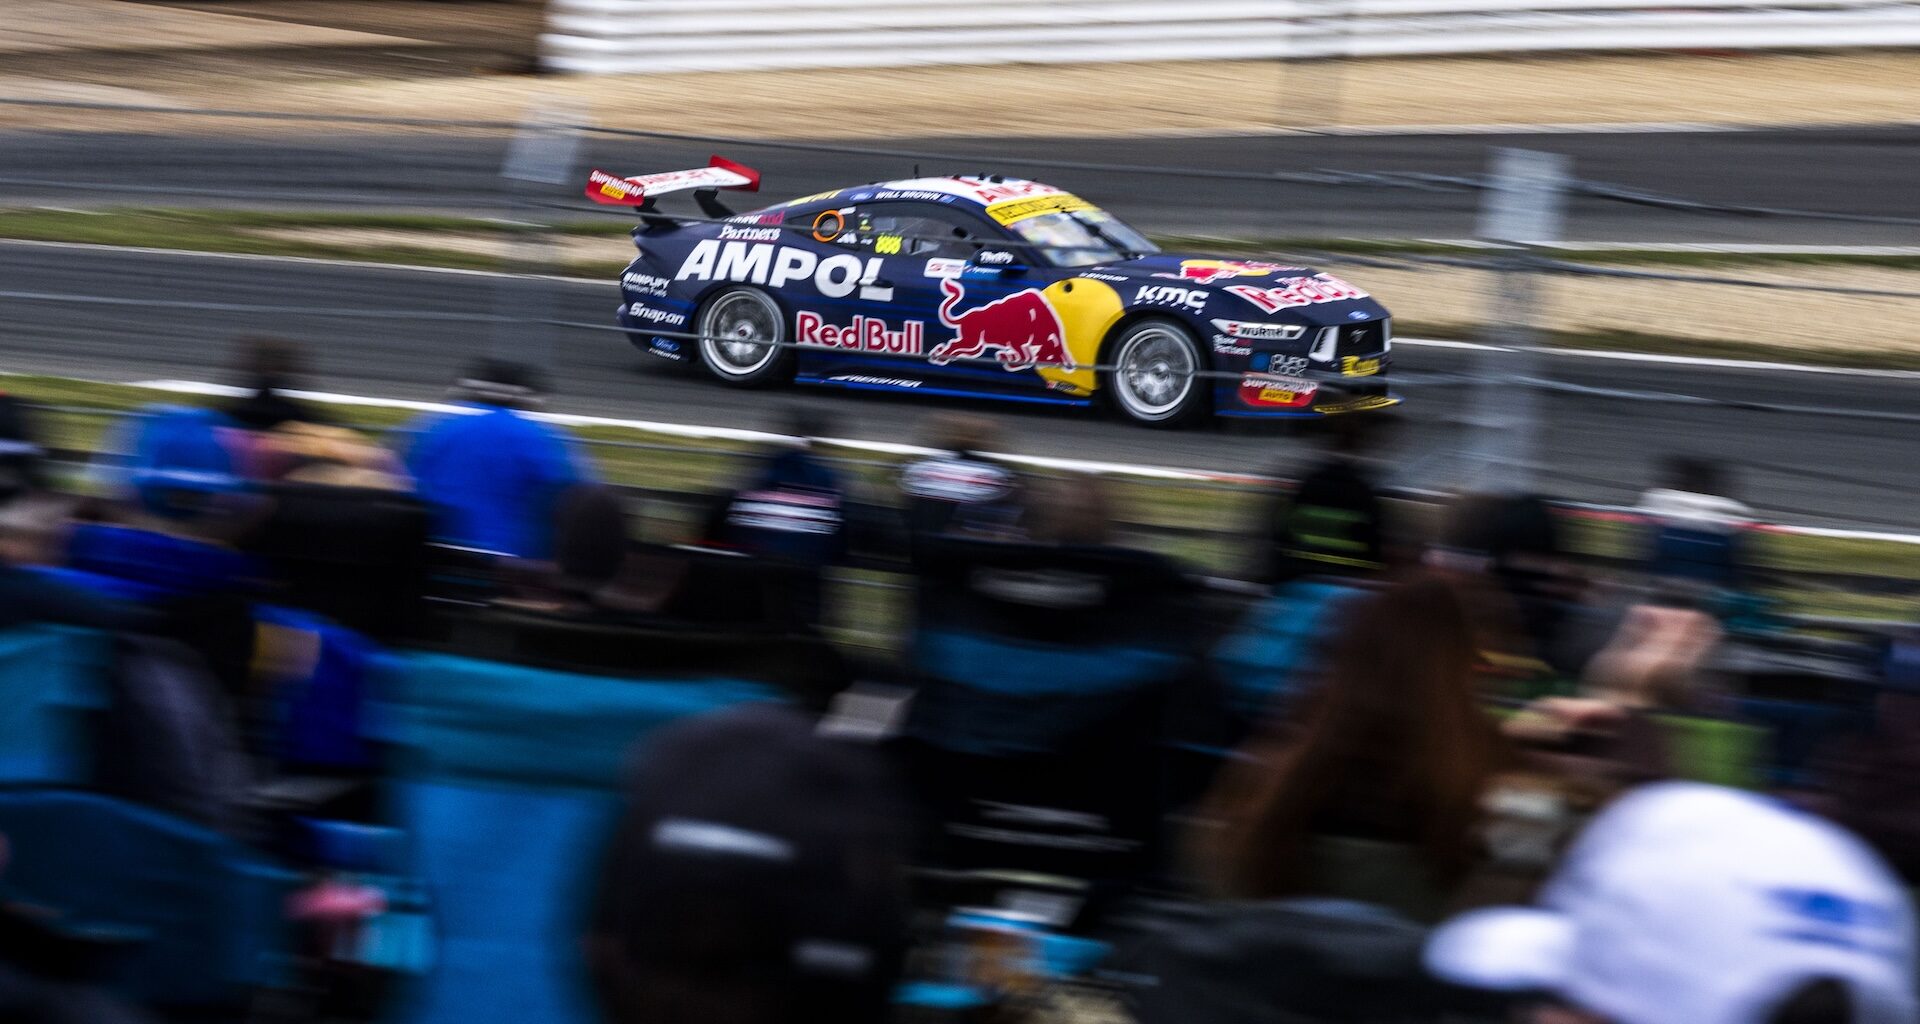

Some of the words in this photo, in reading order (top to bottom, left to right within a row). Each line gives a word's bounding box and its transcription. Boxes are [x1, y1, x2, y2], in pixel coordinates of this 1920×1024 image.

[590, 170, 644, 197] SUPERCHEAP
[875, 191, 901, 200] WILL
[901, 190, 942, 201] BROWN
[717, 224, 781, 241] Partners
[674, 239, 894, 303] AMPOL
